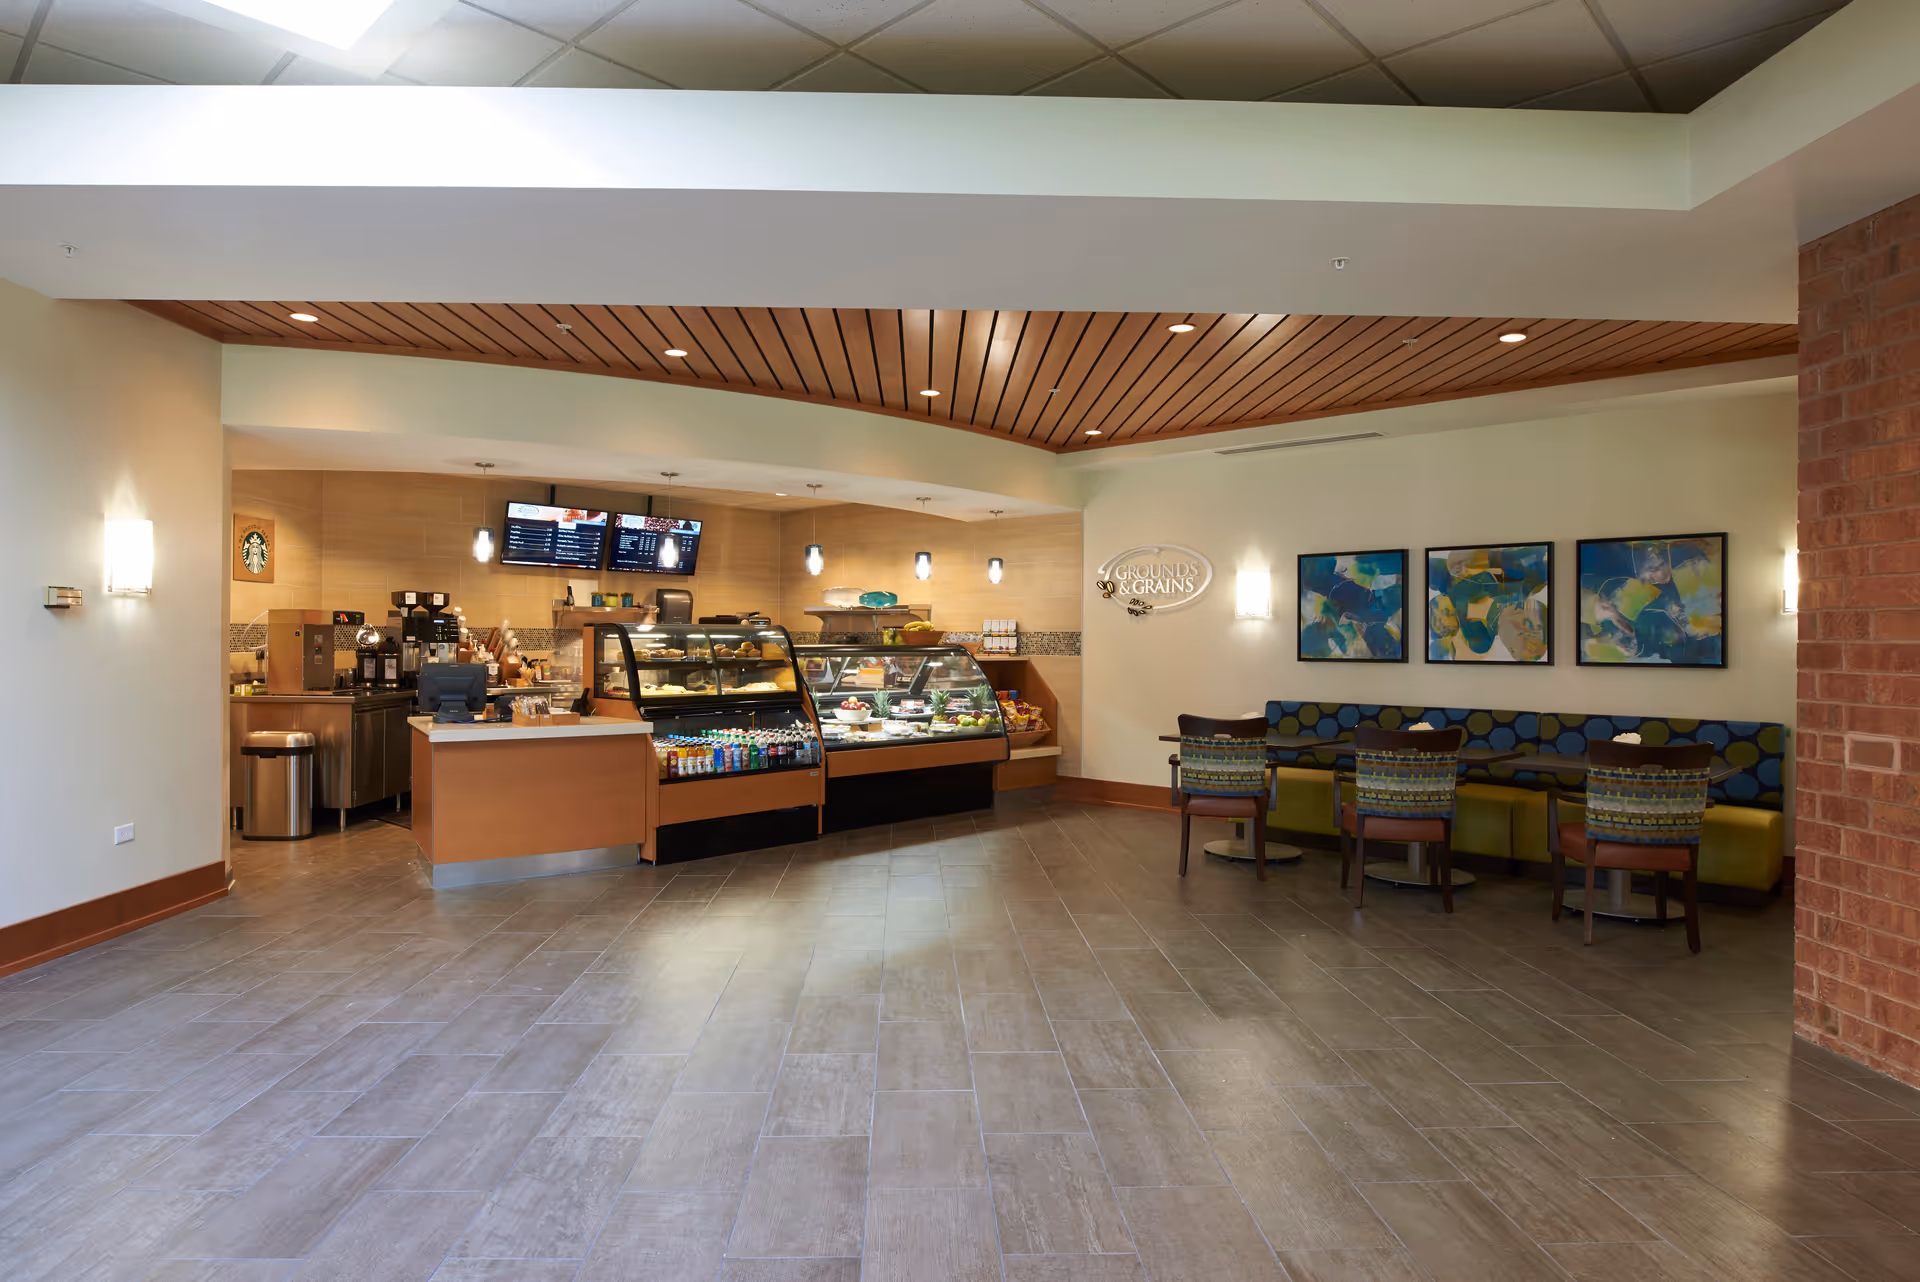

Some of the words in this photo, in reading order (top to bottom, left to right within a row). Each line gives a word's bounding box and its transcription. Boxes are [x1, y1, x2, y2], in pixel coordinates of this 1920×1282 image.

[1115, 560, 1199, 580] GROUNDS
[1119, 581, 1130, 595] &
[1132, 577, 1194, 595] GRAINS
